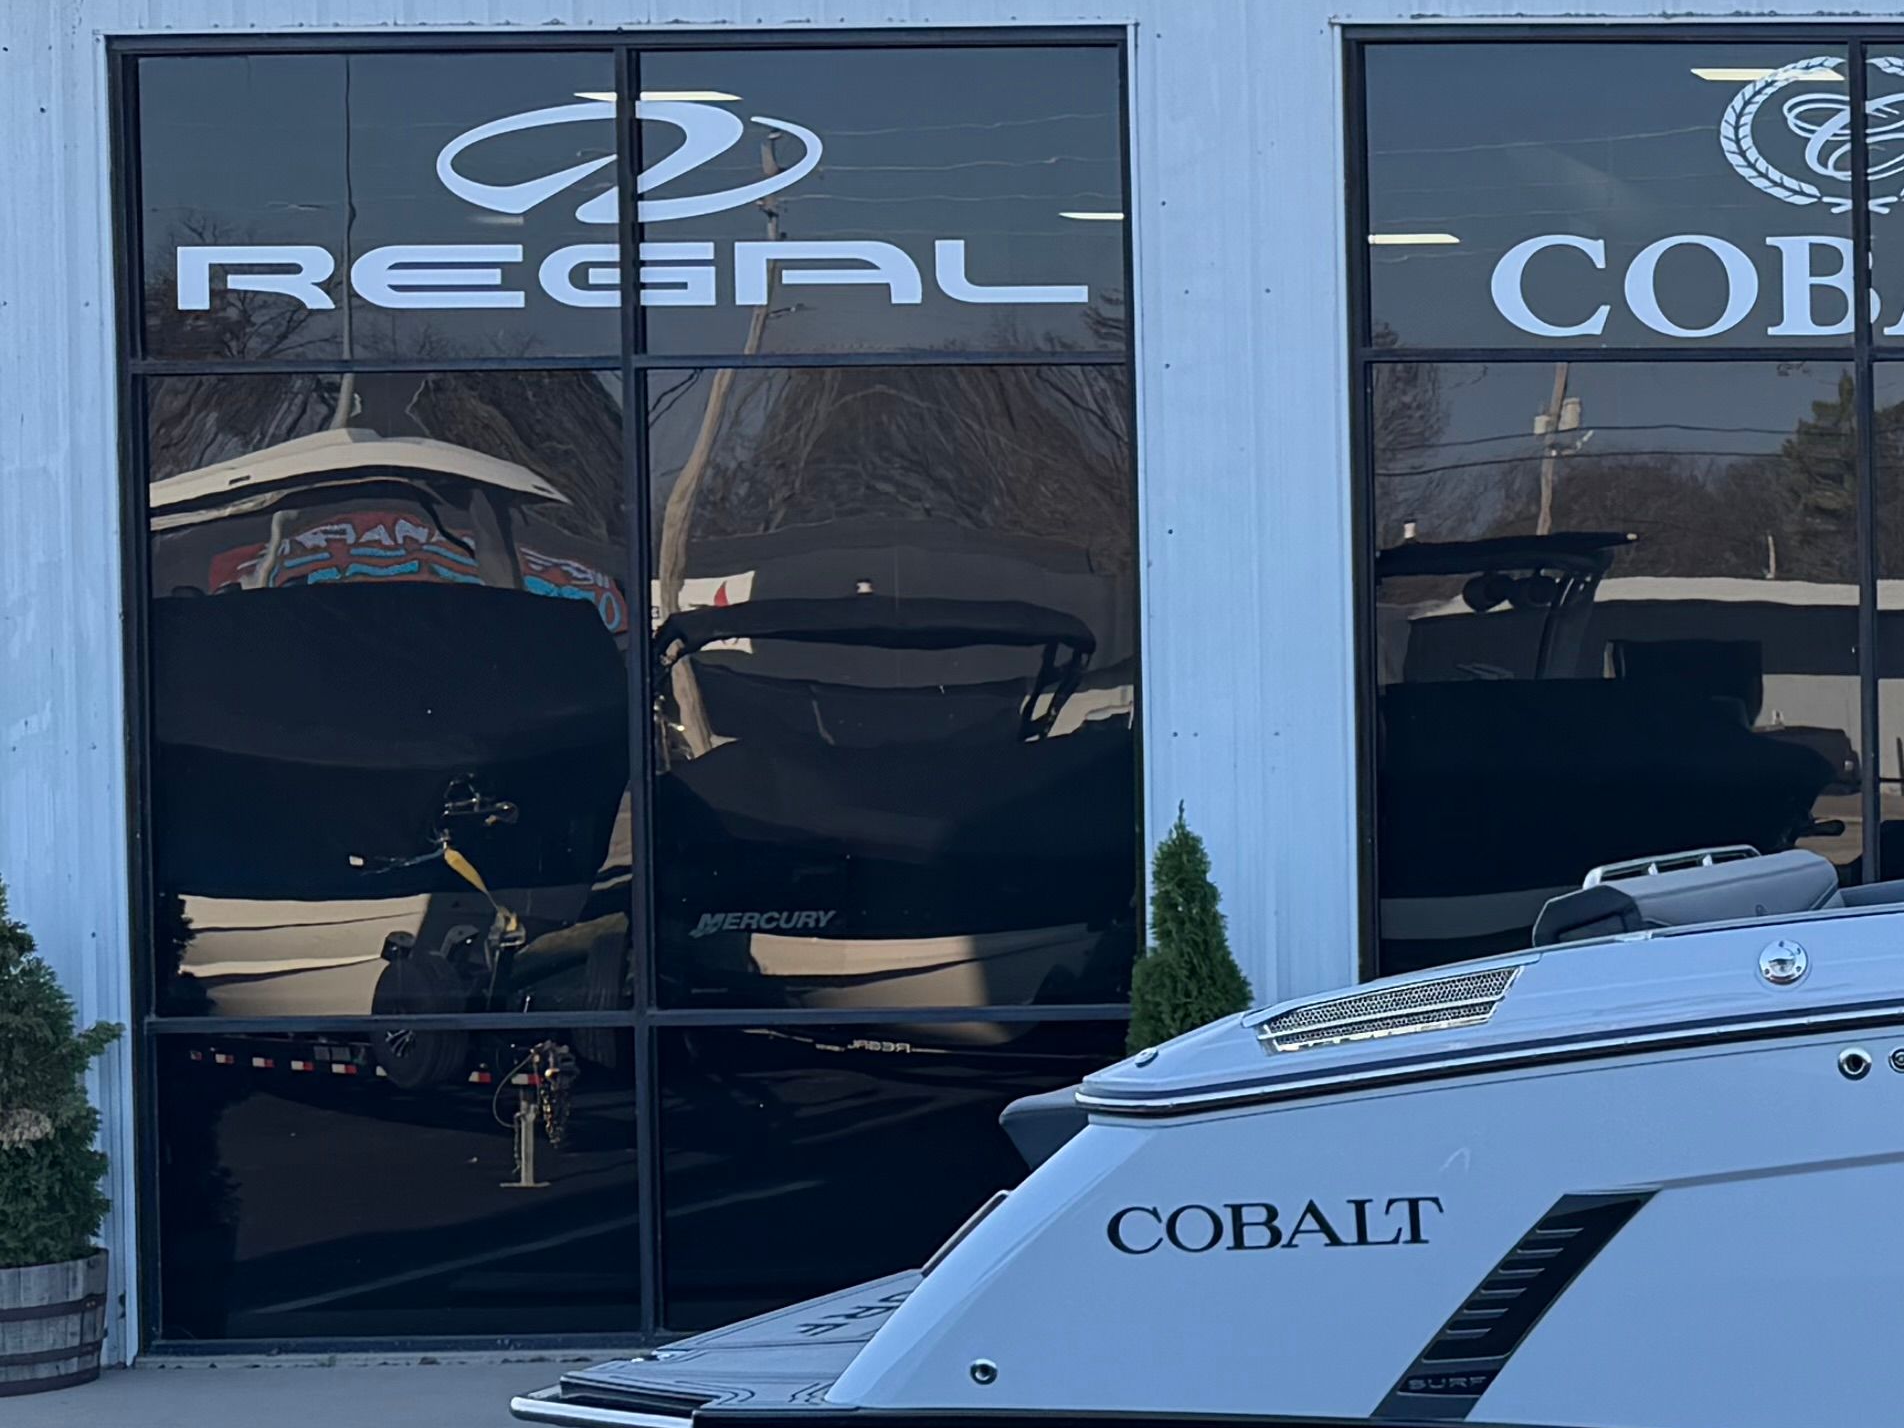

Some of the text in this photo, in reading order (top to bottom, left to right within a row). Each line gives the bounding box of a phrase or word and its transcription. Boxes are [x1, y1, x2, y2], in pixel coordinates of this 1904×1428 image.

[176, 239, 1090, 311] REGAL
[688, 910, 836, 938] MERCURY
[1106, 1196, 1444, 1255] COBALT
[1408, 1375, 1487, 1391] SURF
